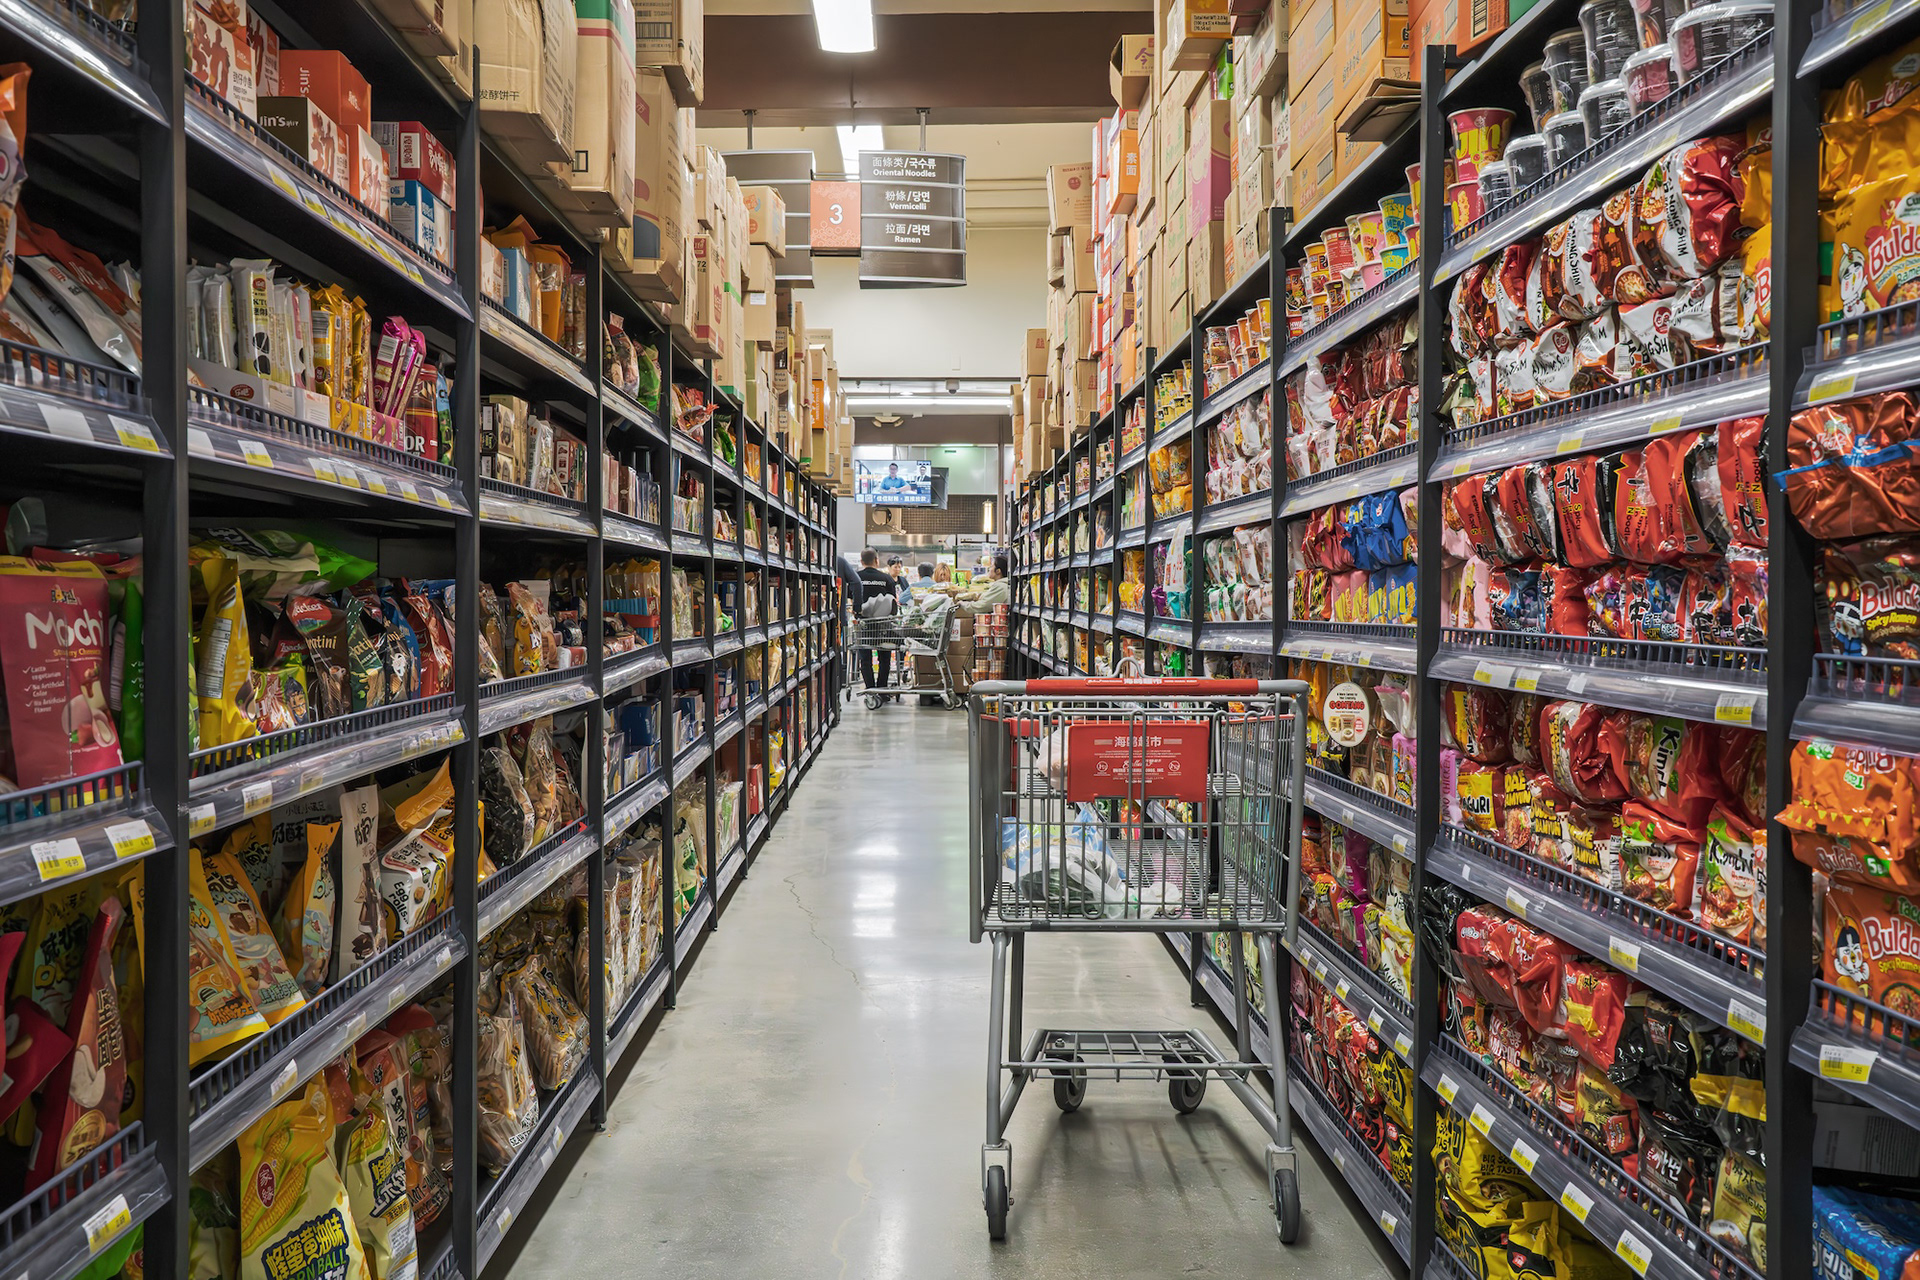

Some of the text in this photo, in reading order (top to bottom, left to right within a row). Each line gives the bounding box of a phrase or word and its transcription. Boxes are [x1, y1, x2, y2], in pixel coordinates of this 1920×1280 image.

[480, 90, 520, 101] 发酵饼干
[873, 169, 936, 178] Oriental Noodles
[1126, 152, 1138, 176] 素面
[829, 203, 844, 225] 3
[886, 224, 930, 235] 拉面/라면
[1860, 579, 1920, 618] Buldak
[25, 608, 104, 650] Mochi
[1866, 611, 1917, 631] Spicy Ramen
[1444, 755, 1452, 794] CHICKEN
[393, 881, 410, 903] Egg
[317, 1249, 347, 1275] BALL
